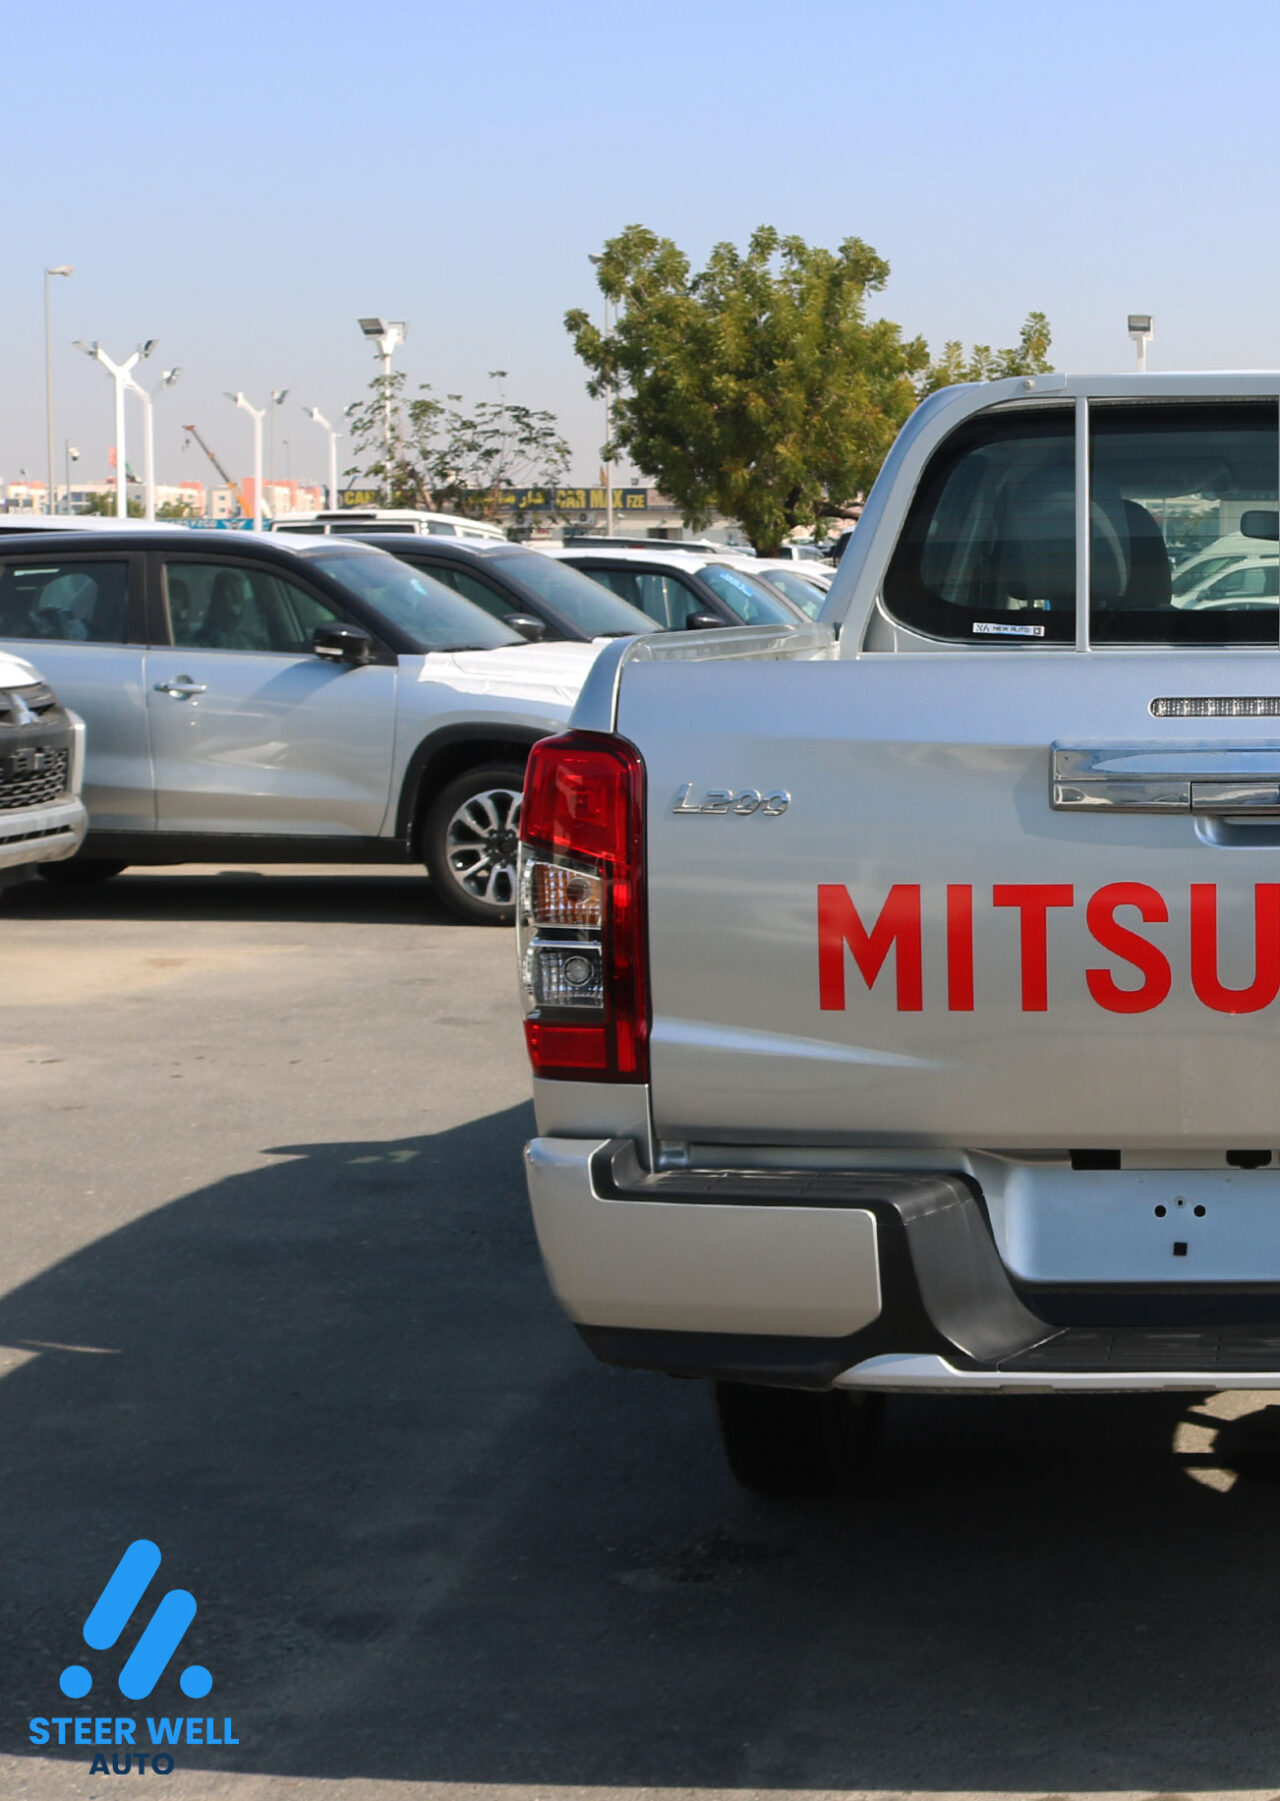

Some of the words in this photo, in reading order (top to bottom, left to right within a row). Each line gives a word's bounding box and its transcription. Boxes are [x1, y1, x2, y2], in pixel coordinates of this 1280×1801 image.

[555, 489, 587, 509] CAR
[626, 494, 646, 509] FZE
[672, 782, 791, 816] L200
